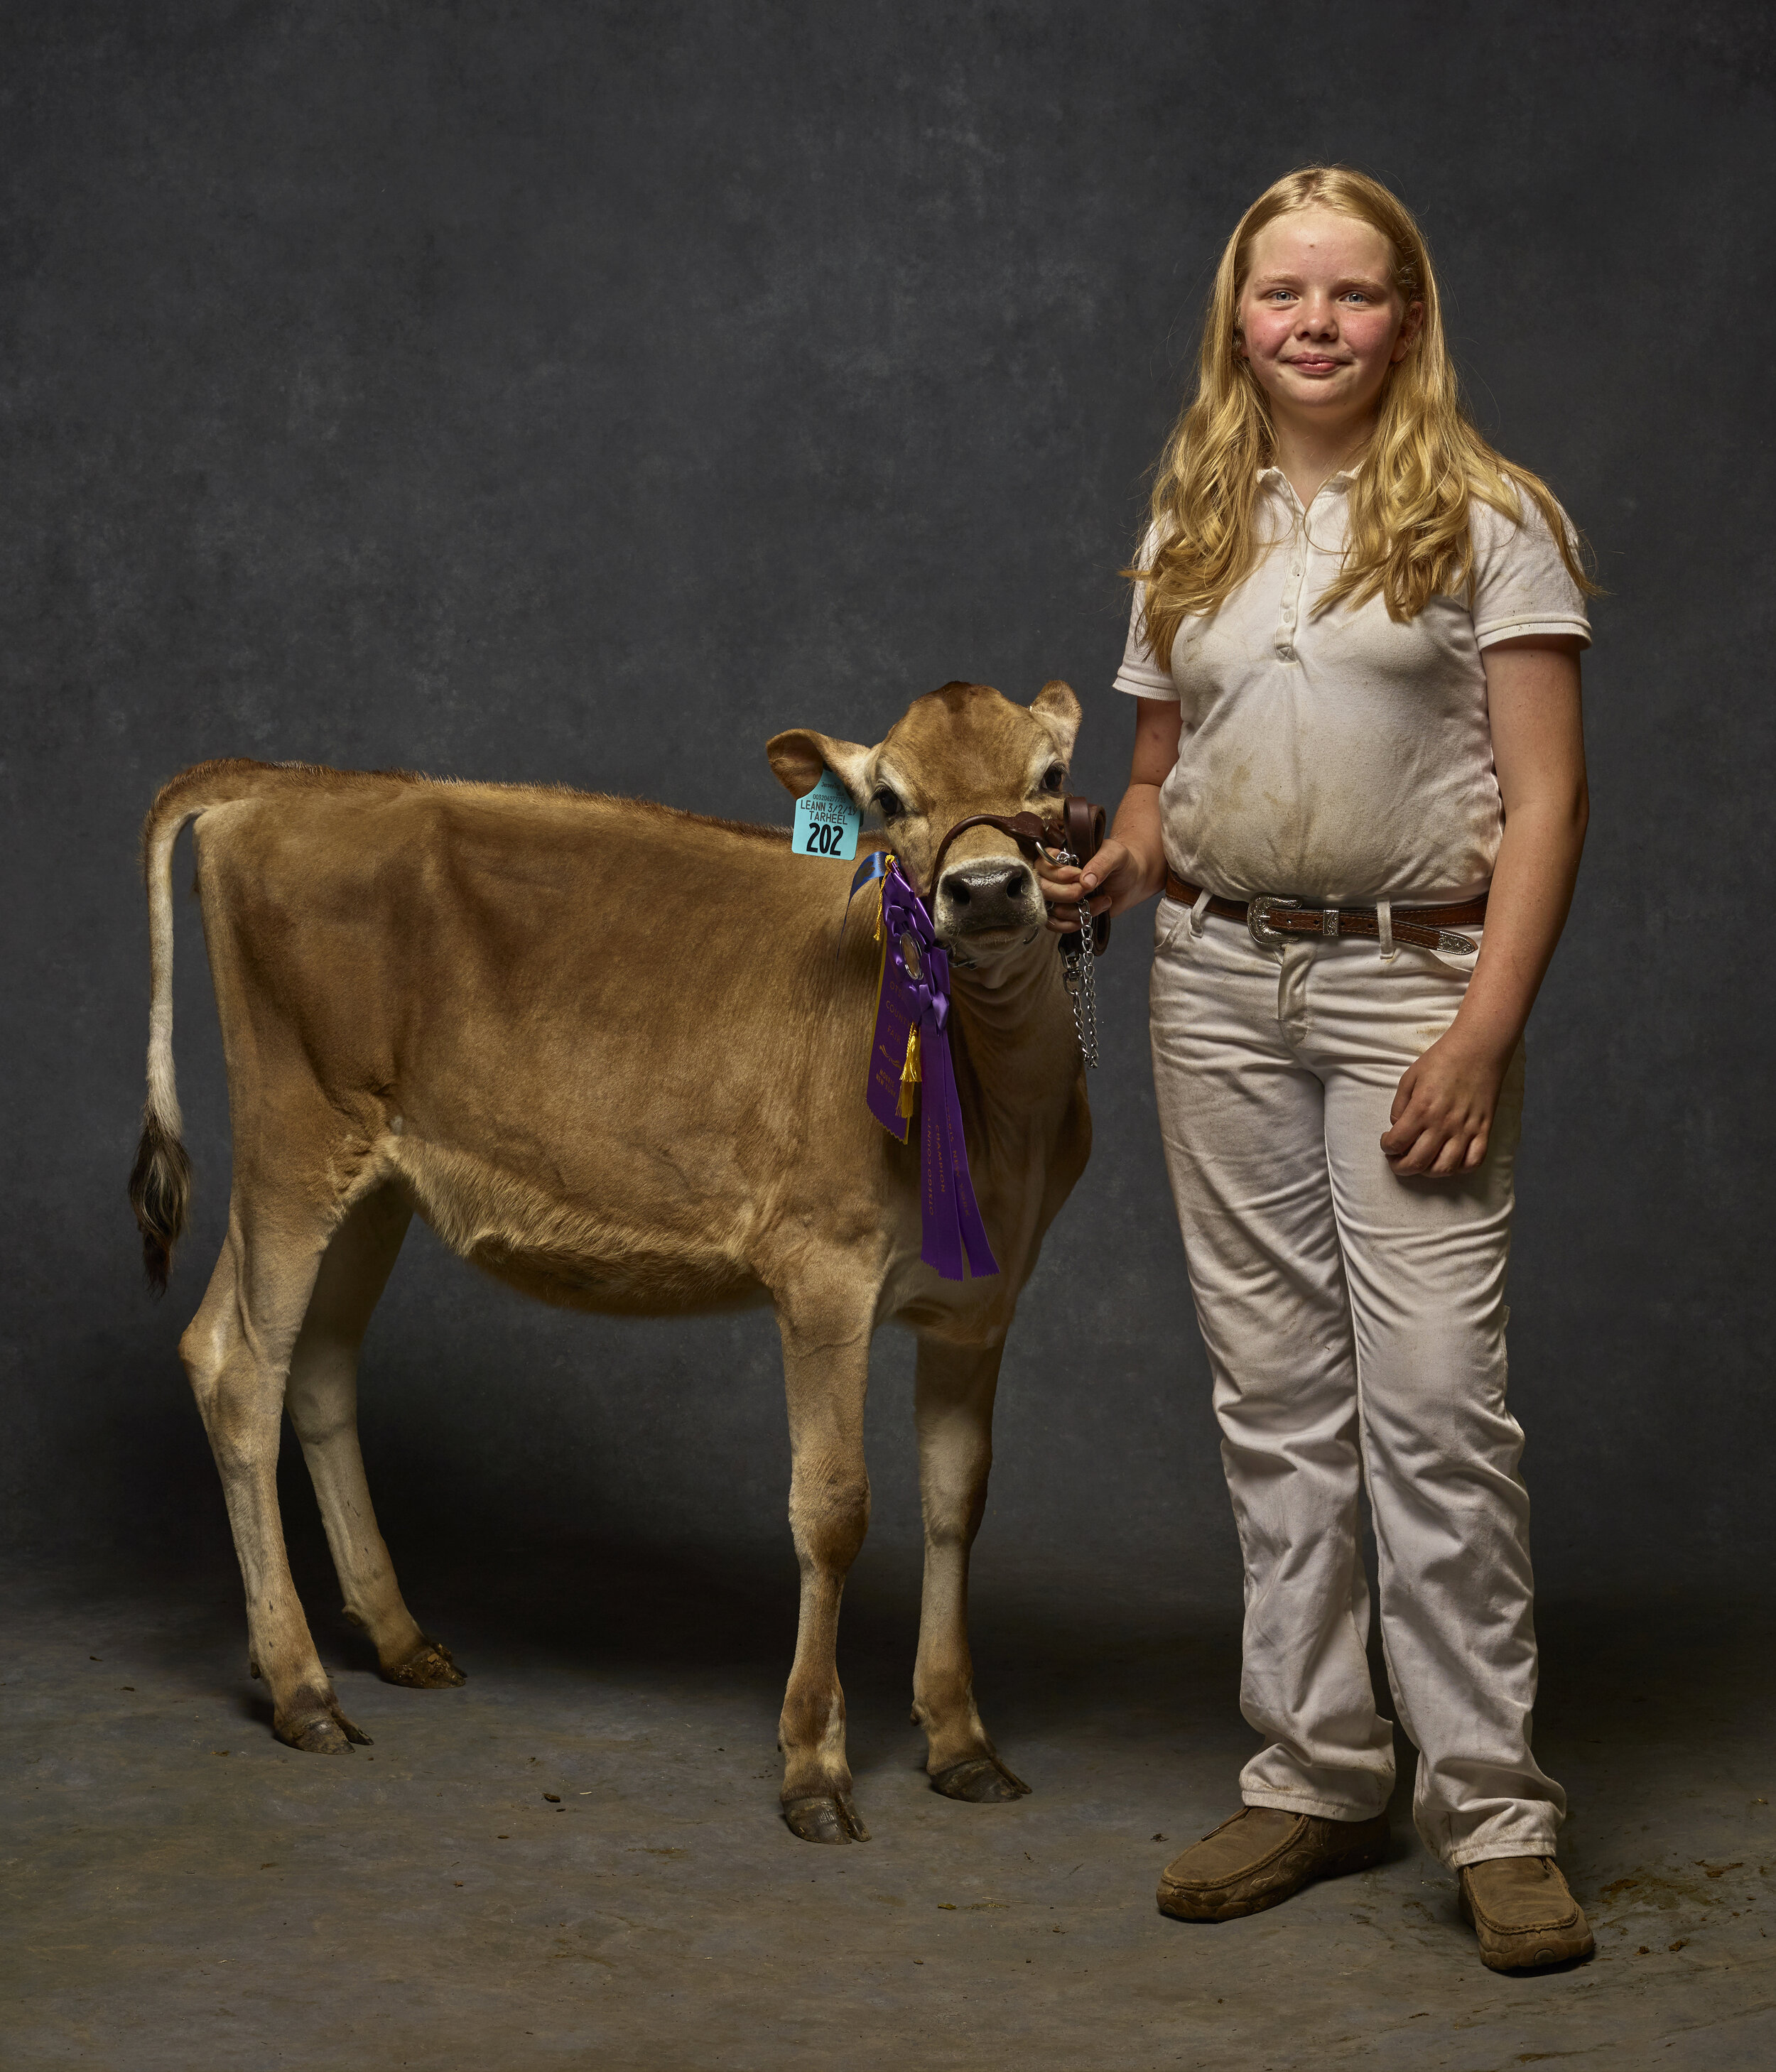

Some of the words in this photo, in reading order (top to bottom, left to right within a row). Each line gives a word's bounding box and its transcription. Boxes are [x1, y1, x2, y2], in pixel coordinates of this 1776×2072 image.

[801, 800, 826, 811] LEANN
[828, 803, 858, 816] 3/2/19
[809, 810, 848, 825] TARHEEL
[806, 823, 844, 856] 202
[887, 1025, 901, 1046] FAIR
[876, 1073, 884, 1086] NEW
[885, 1083, 897, 1098] YORK
[879, 1068, 895, 1087] MORRIS
[935, 1124, 946, 1193] CHAMPION
[952, 1150, 960, 1178] NEW
[960, 1183, 970, 1217] YORK
